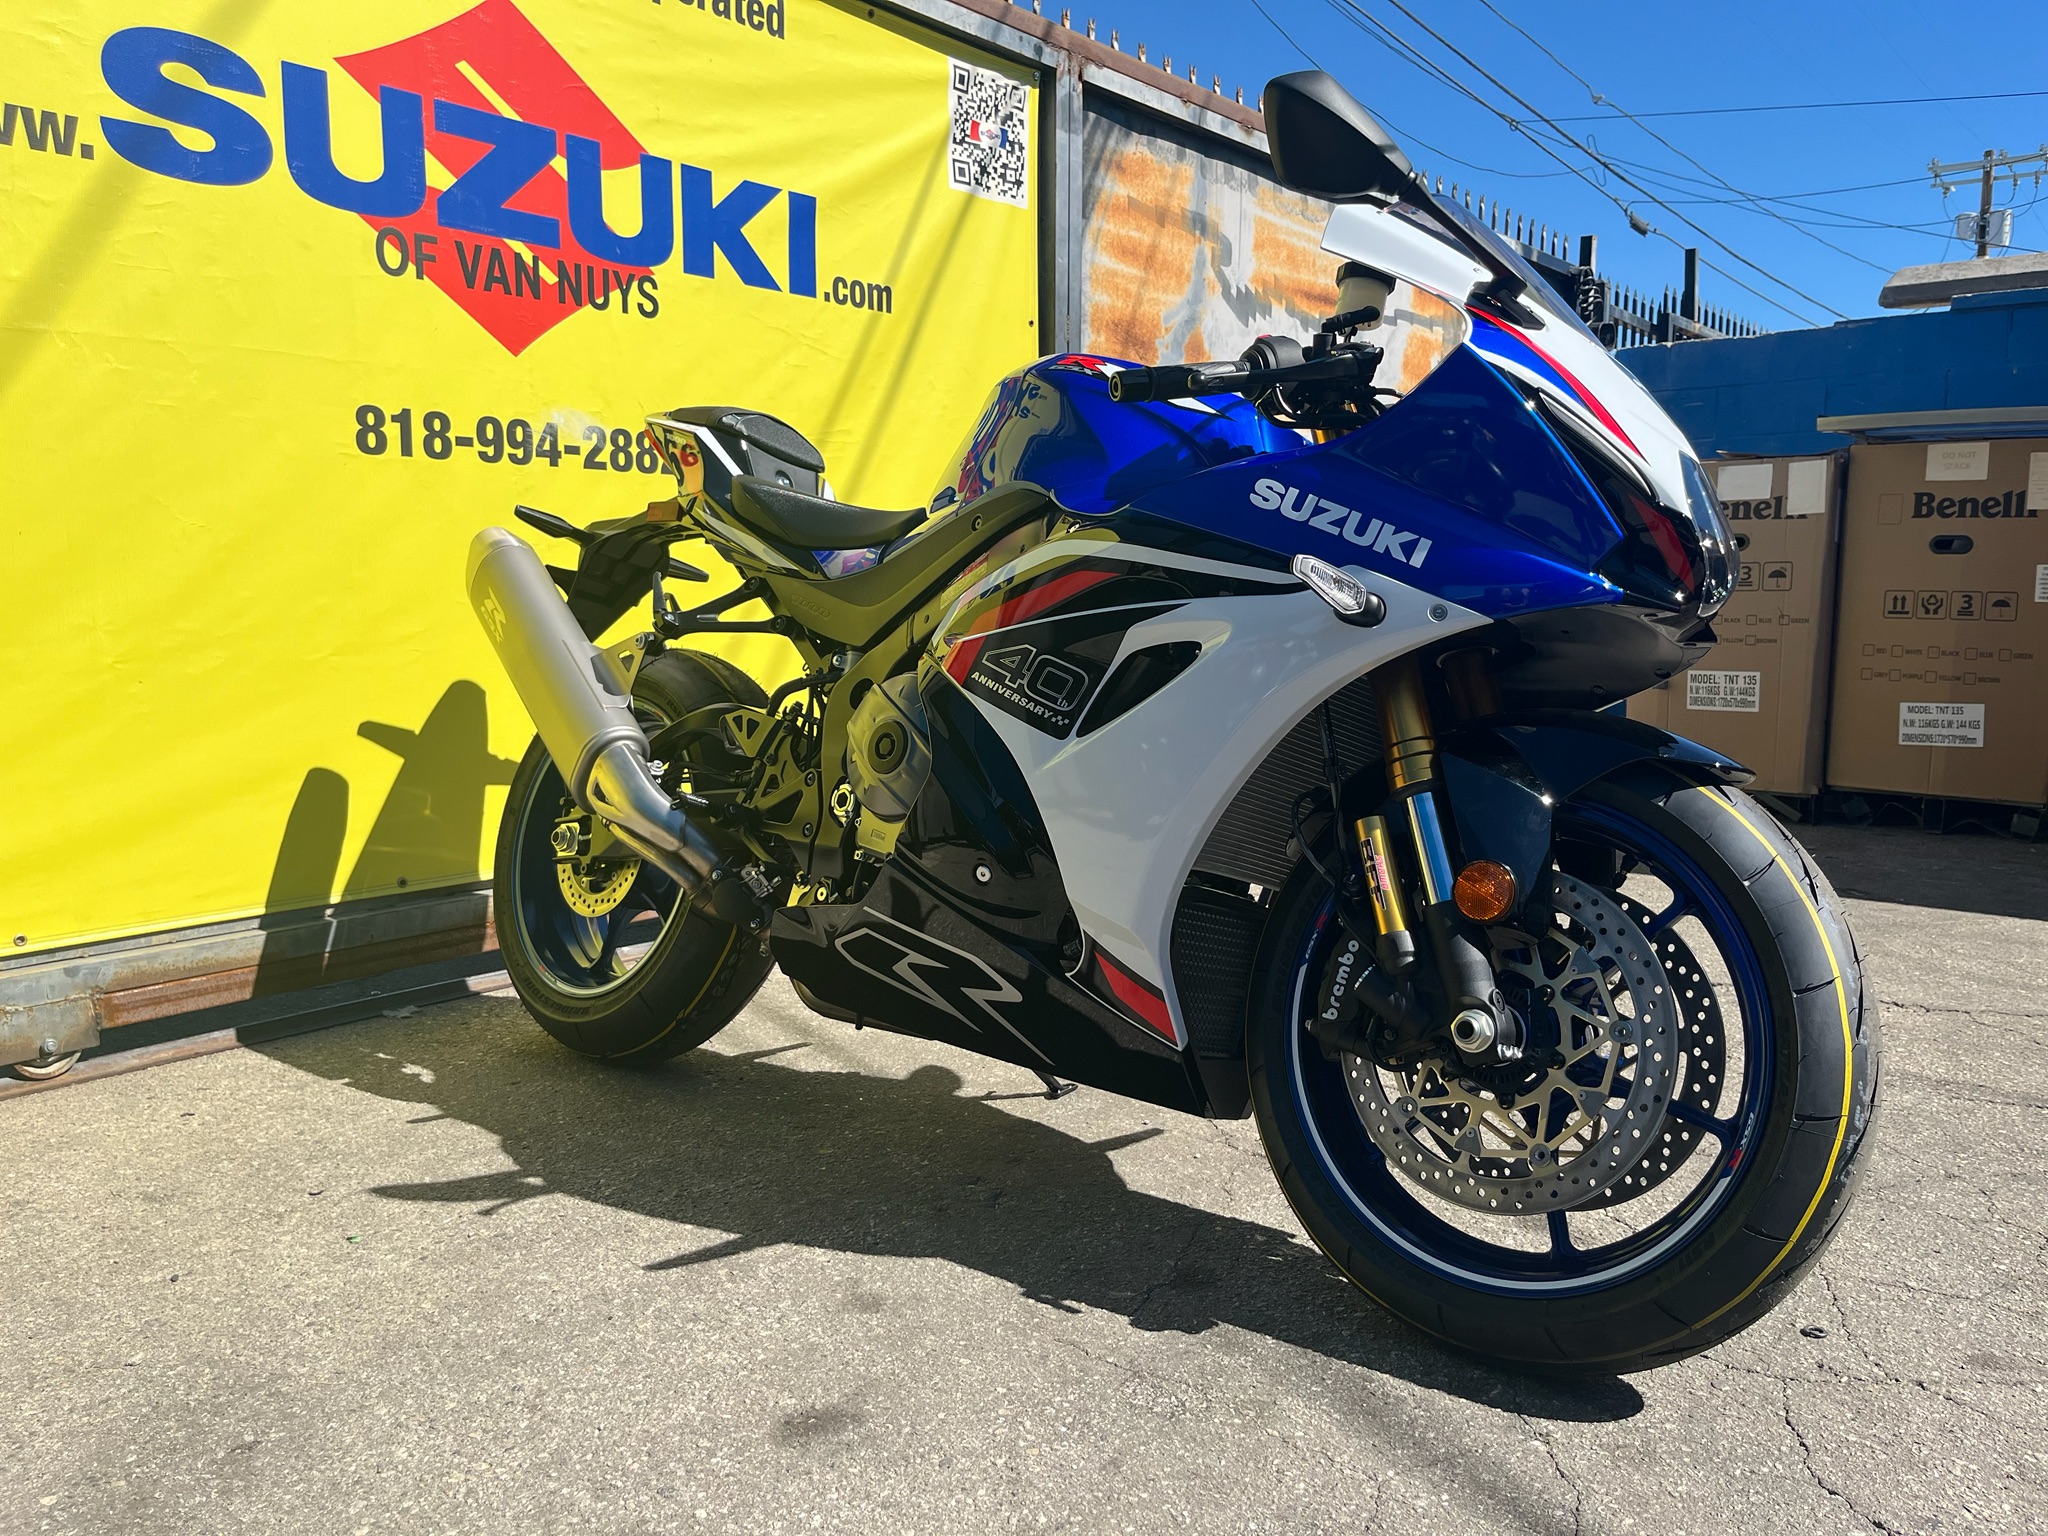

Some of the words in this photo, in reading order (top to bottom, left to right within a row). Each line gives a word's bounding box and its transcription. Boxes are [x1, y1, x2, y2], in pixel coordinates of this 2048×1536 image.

[99, 26, 817, 299] SUZUKI
[824, 276, 892, 314] .com
[376, 226, 437, 279] OF
[455, 240, 541, 300] VAN
[558, 259, 659, 319] NUYS
[355, 404, 677, 475] 818-994-288
[1249, 478, 1433, 569] SUZUKI
[970, 671, 1054, 719] ANNIVERSARY
[1690, 673, 1721, 685] MODEL:
[1723, 674, 1740, 685] TNT
[1742, 675, 1758, 686] 135
[1907, 705, 1934, 715] MODEL:
[1935, 706, 1950, 715] TNT
[1951, 706, 1965, 715] 135
[1968, 720, 1981, 730] KGS
[1322, 939, 1360, 1020] brembo
